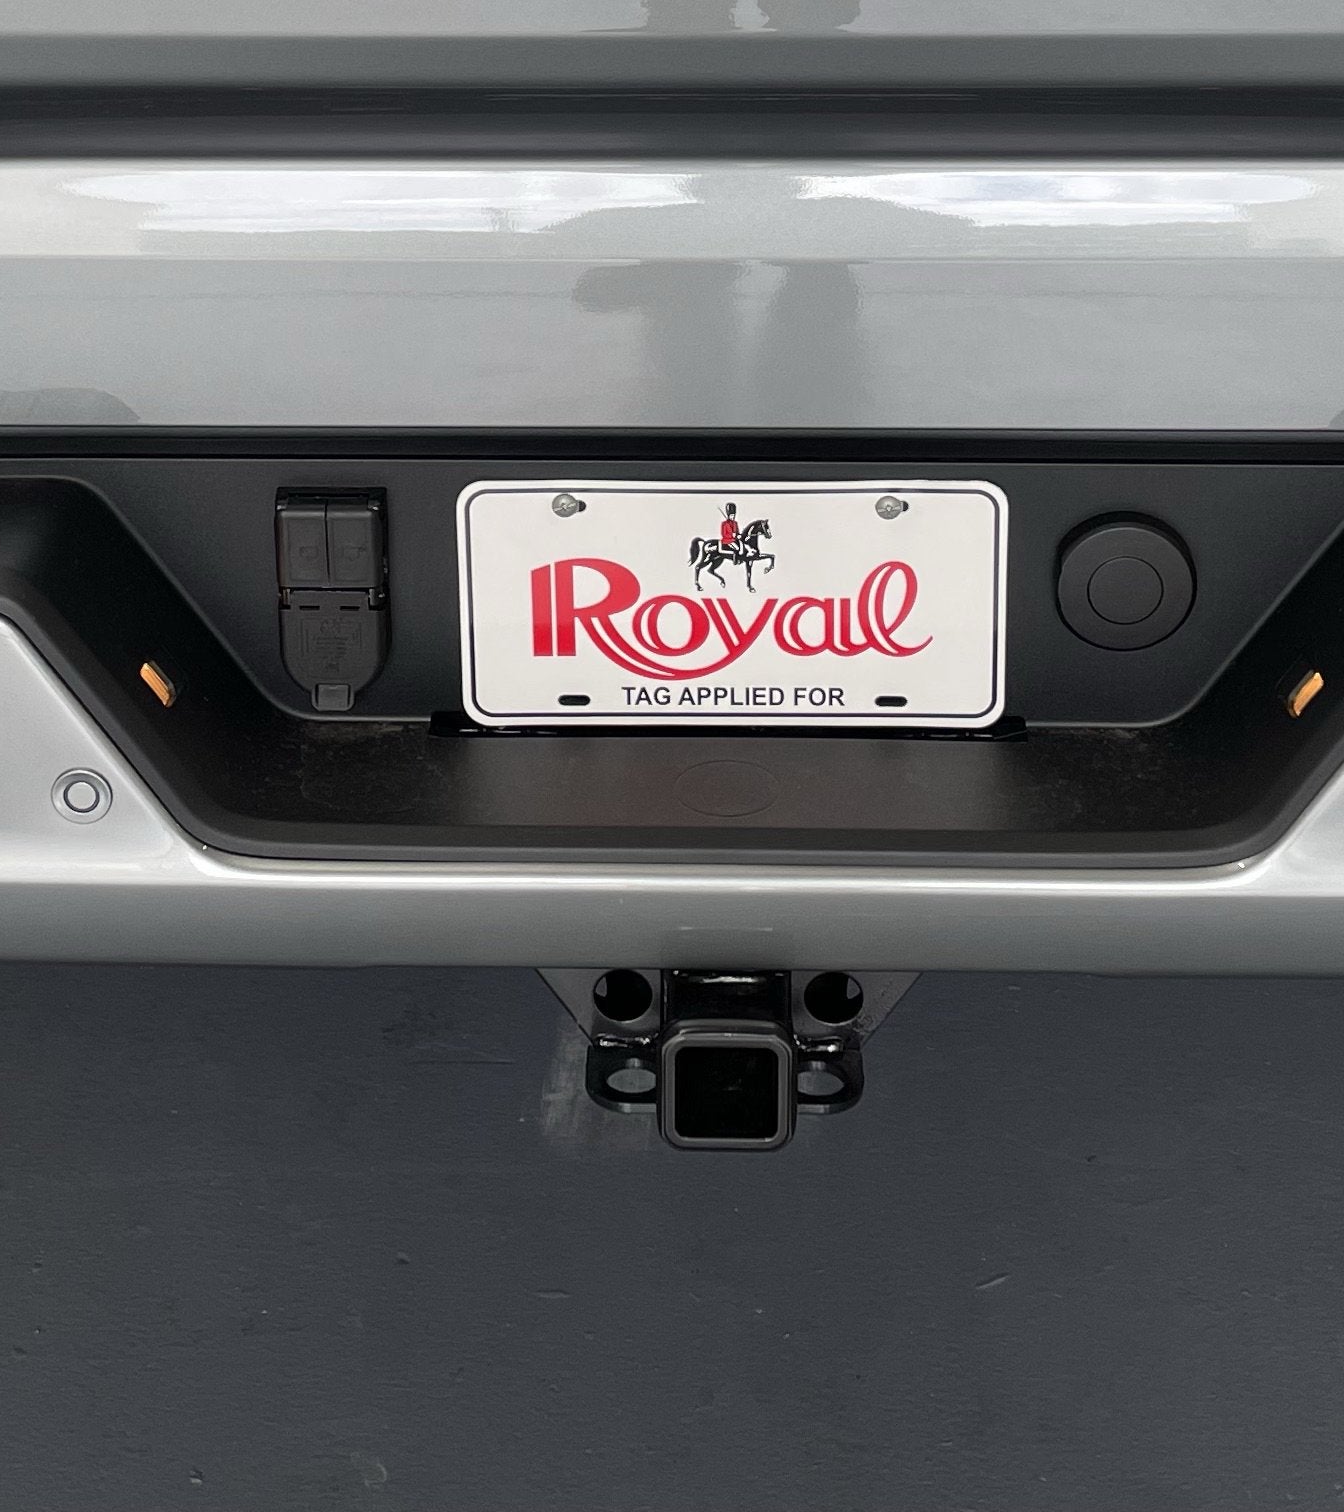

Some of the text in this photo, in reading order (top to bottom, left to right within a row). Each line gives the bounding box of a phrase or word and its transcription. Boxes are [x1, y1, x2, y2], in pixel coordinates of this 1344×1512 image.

[530, 557, 934, 681] Royal
[621, 686, 846, 708] TAG APPLIED FOR
